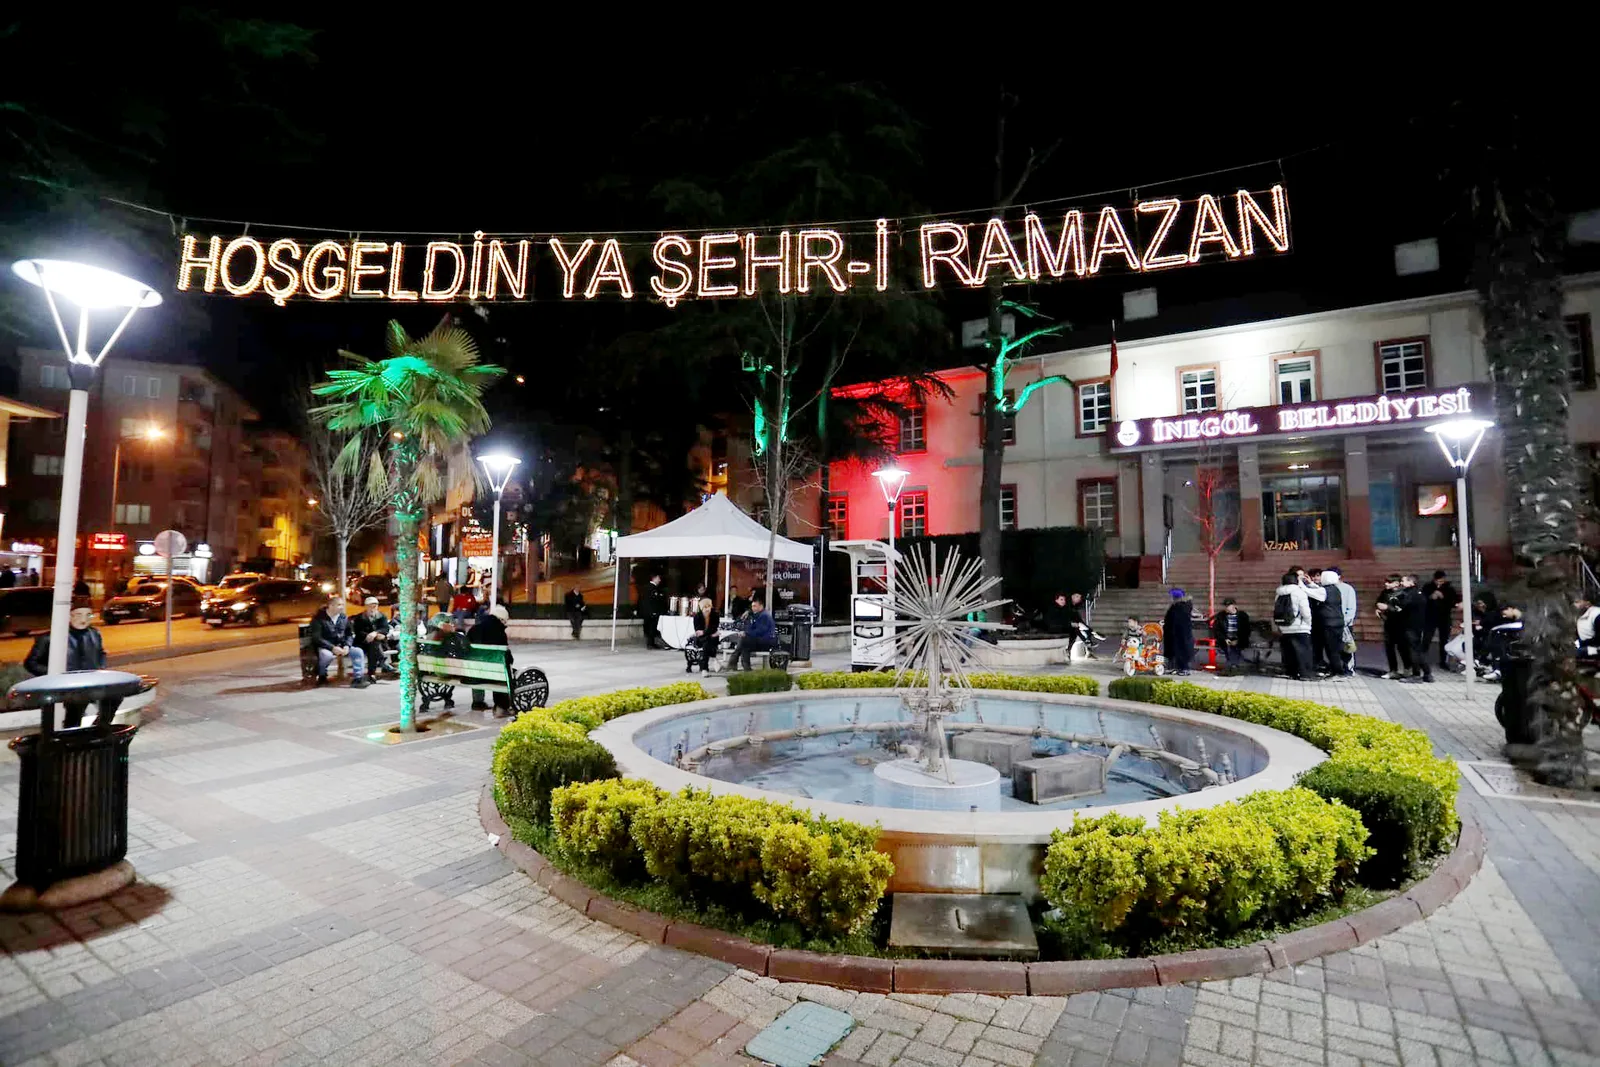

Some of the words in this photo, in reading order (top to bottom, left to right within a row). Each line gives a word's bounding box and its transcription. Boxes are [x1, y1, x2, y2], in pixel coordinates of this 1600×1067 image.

[177, 230, 528, 306] HOŞGELDİN
[549, 237, 634, 299] YA
[650, 217, 889, 307] ŞEHR-İ
[920, 185, 1291, 288] RAMAZAN
[1152, 411, 1259, 443] İNEGÖL
[1278, 387, 1473, 431] BELEDİYESİ
